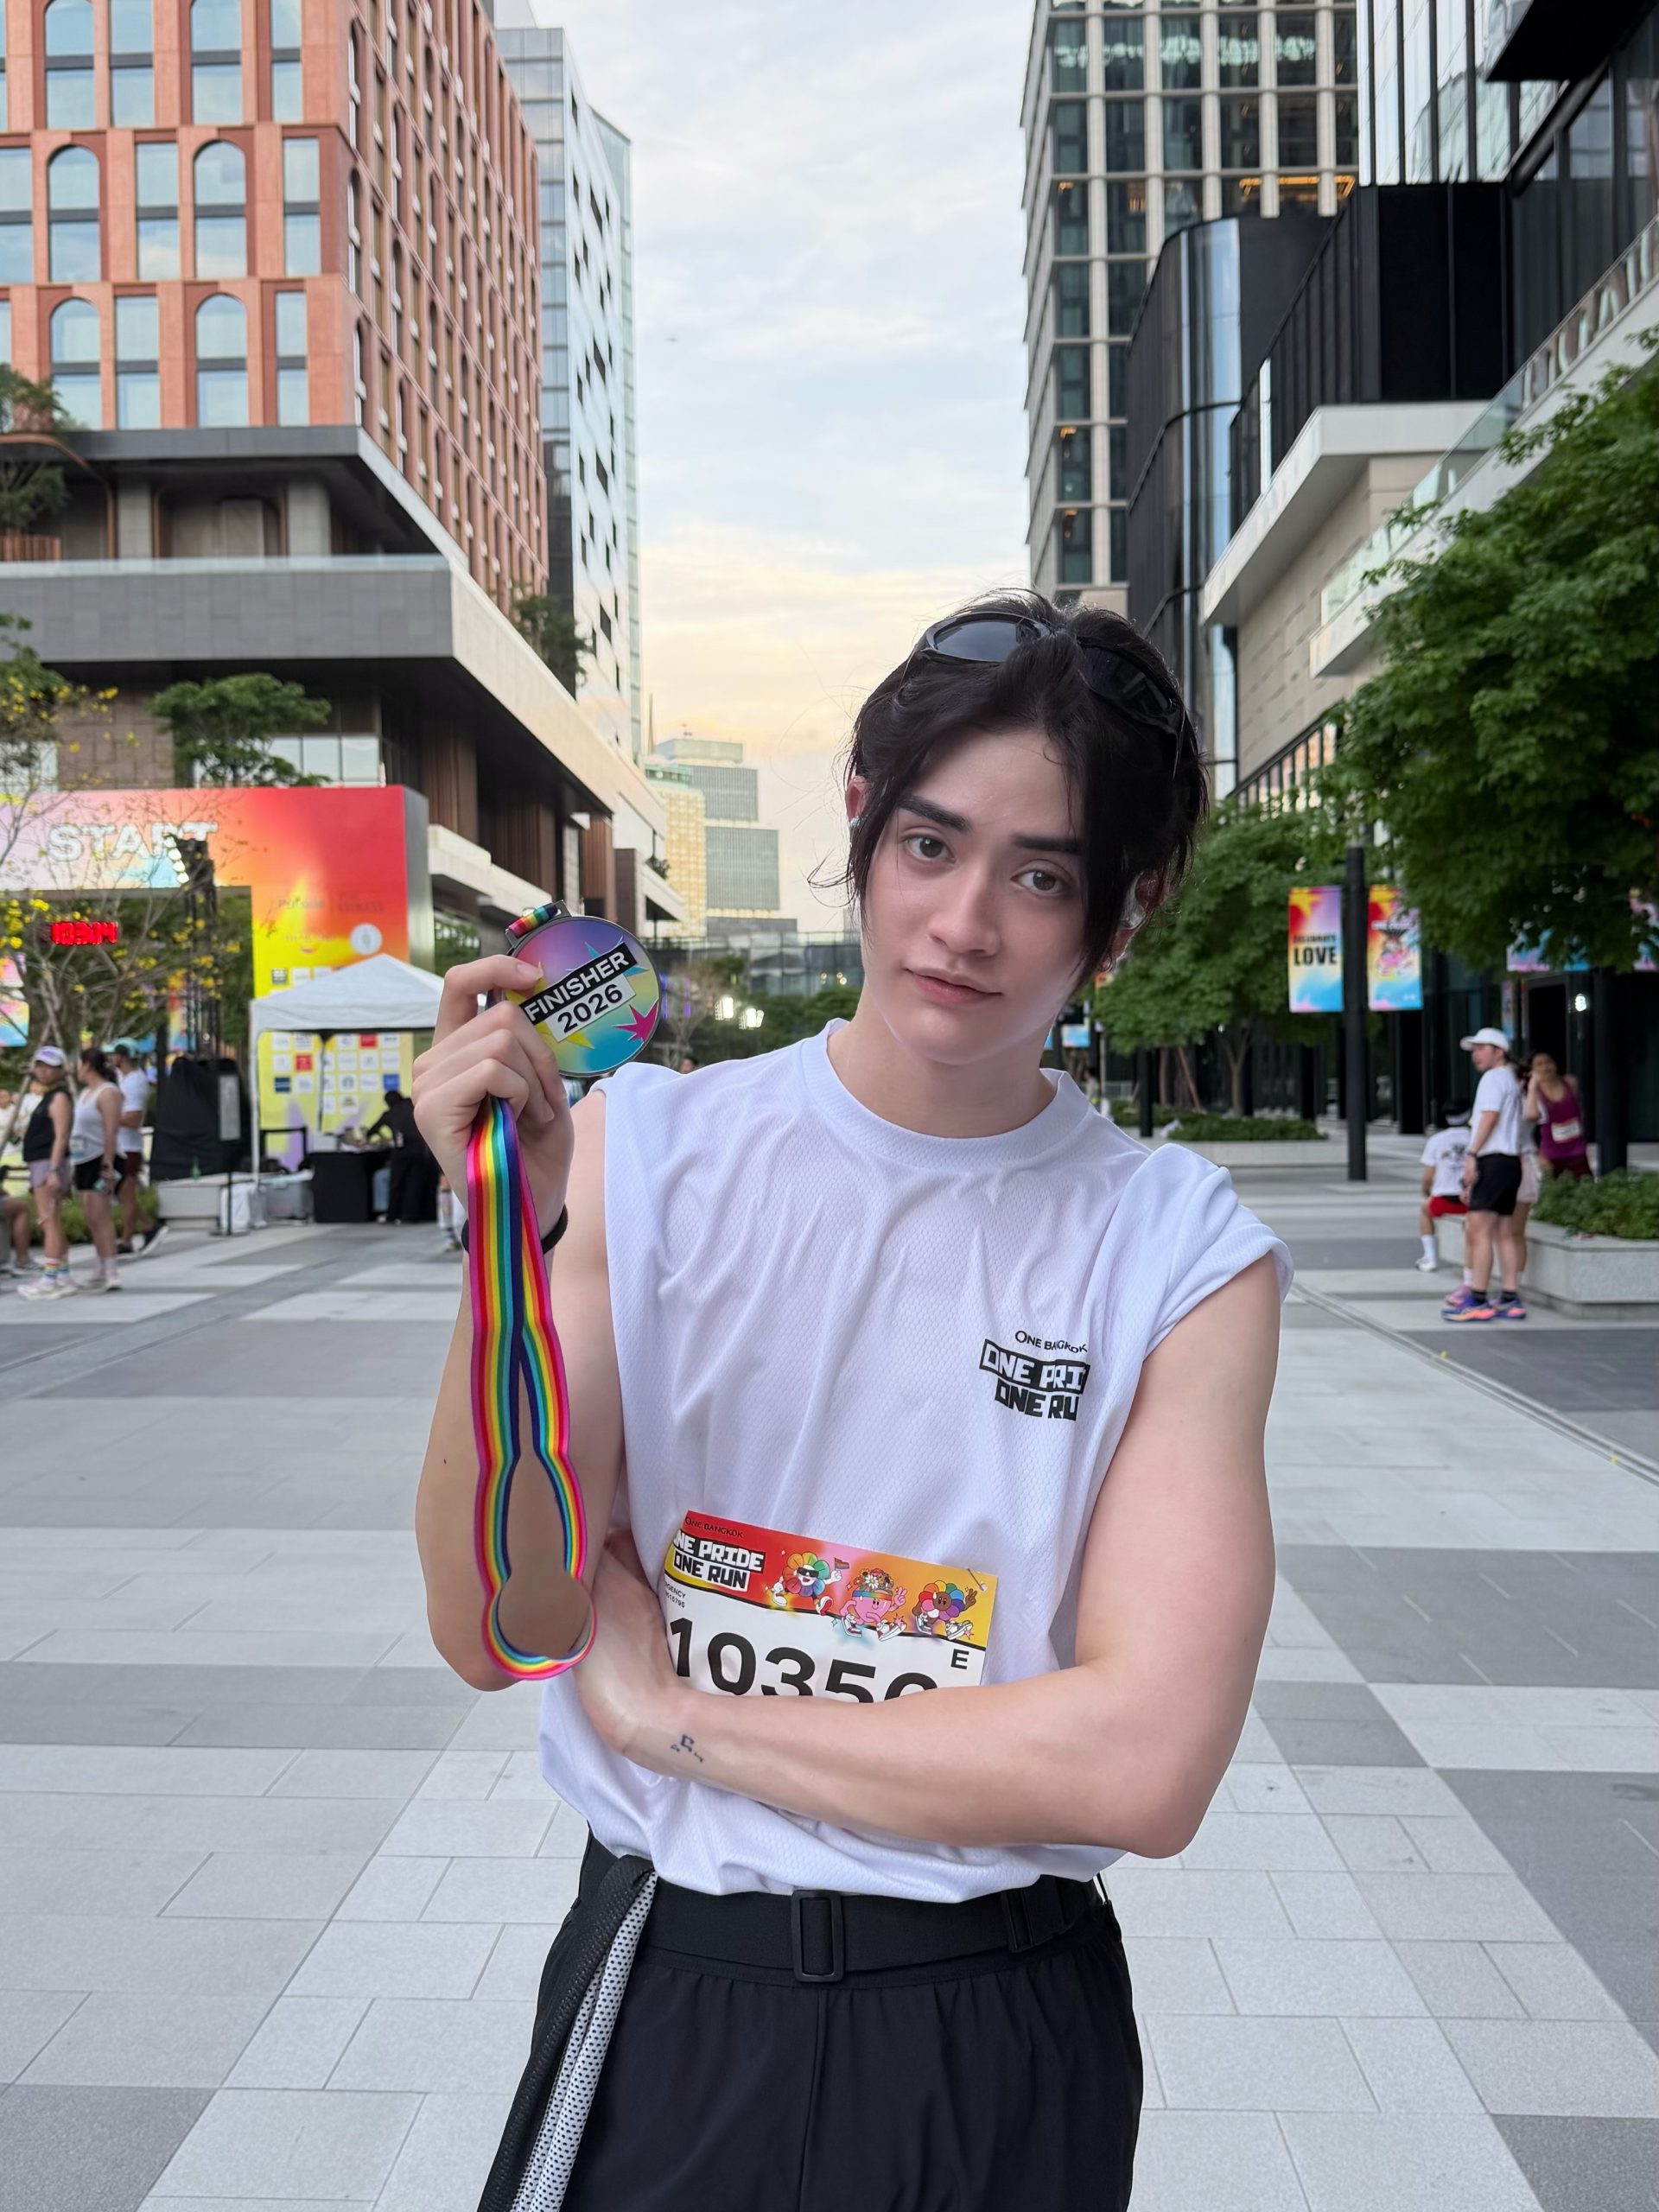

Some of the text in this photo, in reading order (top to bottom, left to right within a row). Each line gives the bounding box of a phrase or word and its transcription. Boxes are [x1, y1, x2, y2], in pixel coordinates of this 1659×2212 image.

[1293, 946, 1337, 966] LOVE
[524, 951, 629, 1022] FINISHER
[557, 983, 623, 1033] 2026
[1015, 1331, 1042, 1348] ONE
[982, 1343, 1035, 1384] ONE
[995, 1377, 1080, 1421] ONE RU
[684, 1516, 743, 1538] ONE BANGKOK
[673, 1529, 765, 1572] NE PRIDE
[674, 1550, 747, 1589] ONE RUN
[950, 1649, 969, 1669] E
